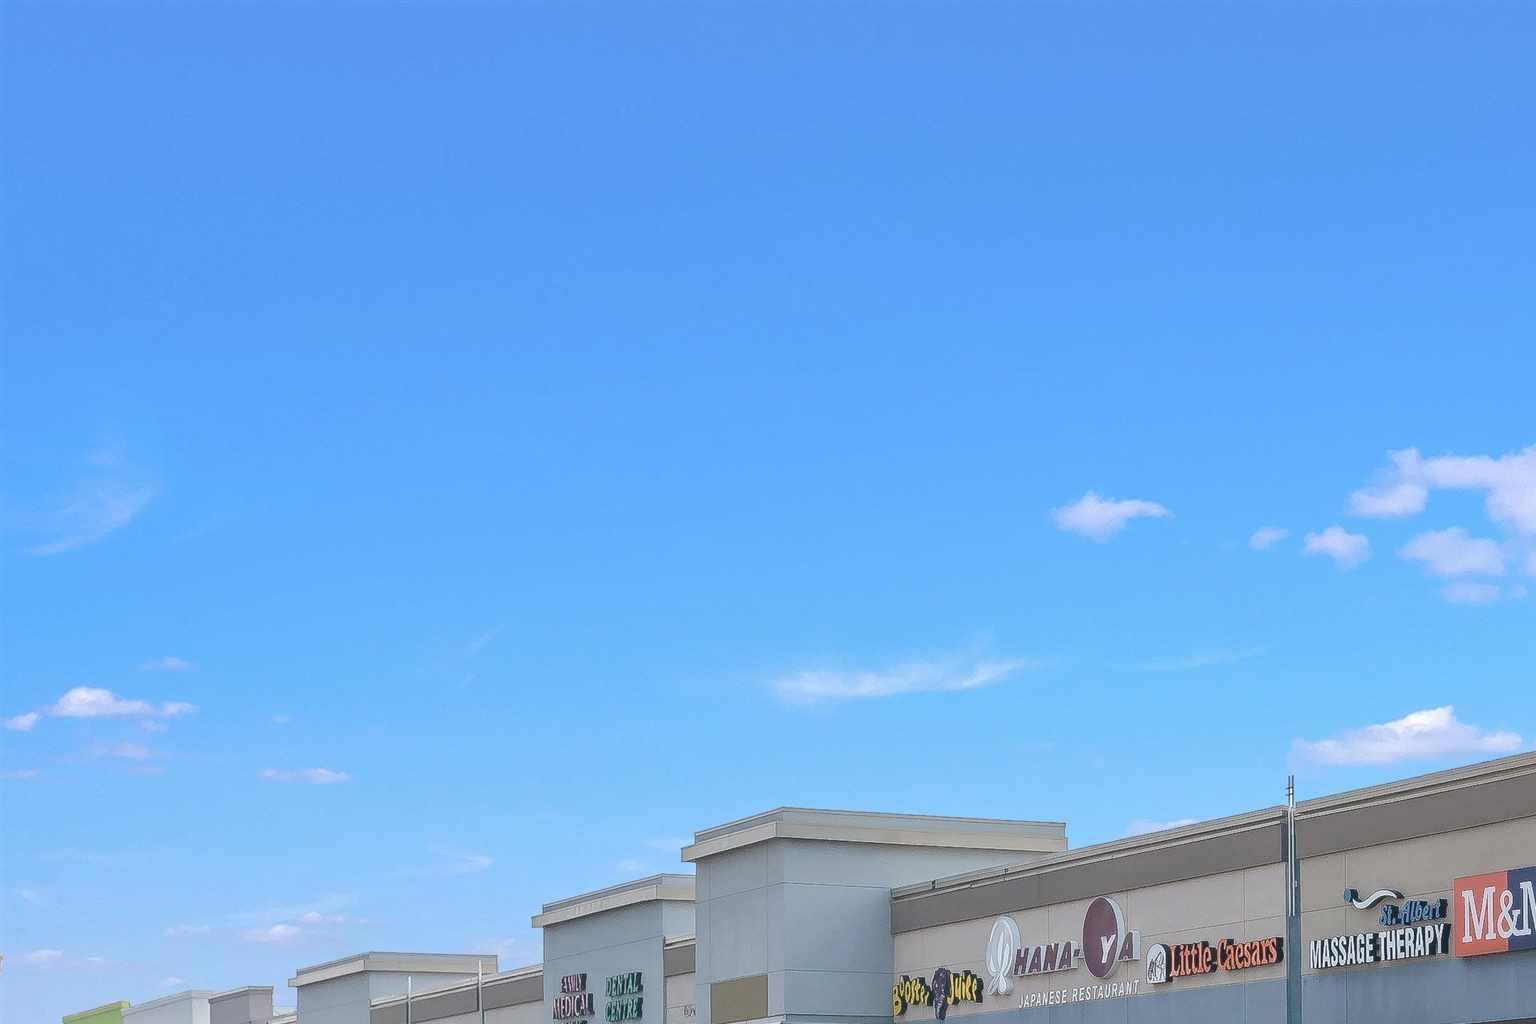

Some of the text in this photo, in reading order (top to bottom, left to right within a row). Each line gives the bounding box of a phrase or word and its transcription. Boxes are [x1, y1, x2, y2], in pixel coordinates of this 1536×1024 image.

[1399, 899, 1448, 924] Albert
[1169, 937, 1281, 977] Little Caesars
[1309, 924, 1450, 968] MASSAGE THERAPY
[606, 972, 643, 997] DENTAL
[893, 971, 981, 1016] Booster Juice
[1018, 980, 1140, 1008] JAPANESE RESTAURANT
[553, 993, 595, 1019] MEDICAL
[606, 997, 643, 1022] CENTRE
